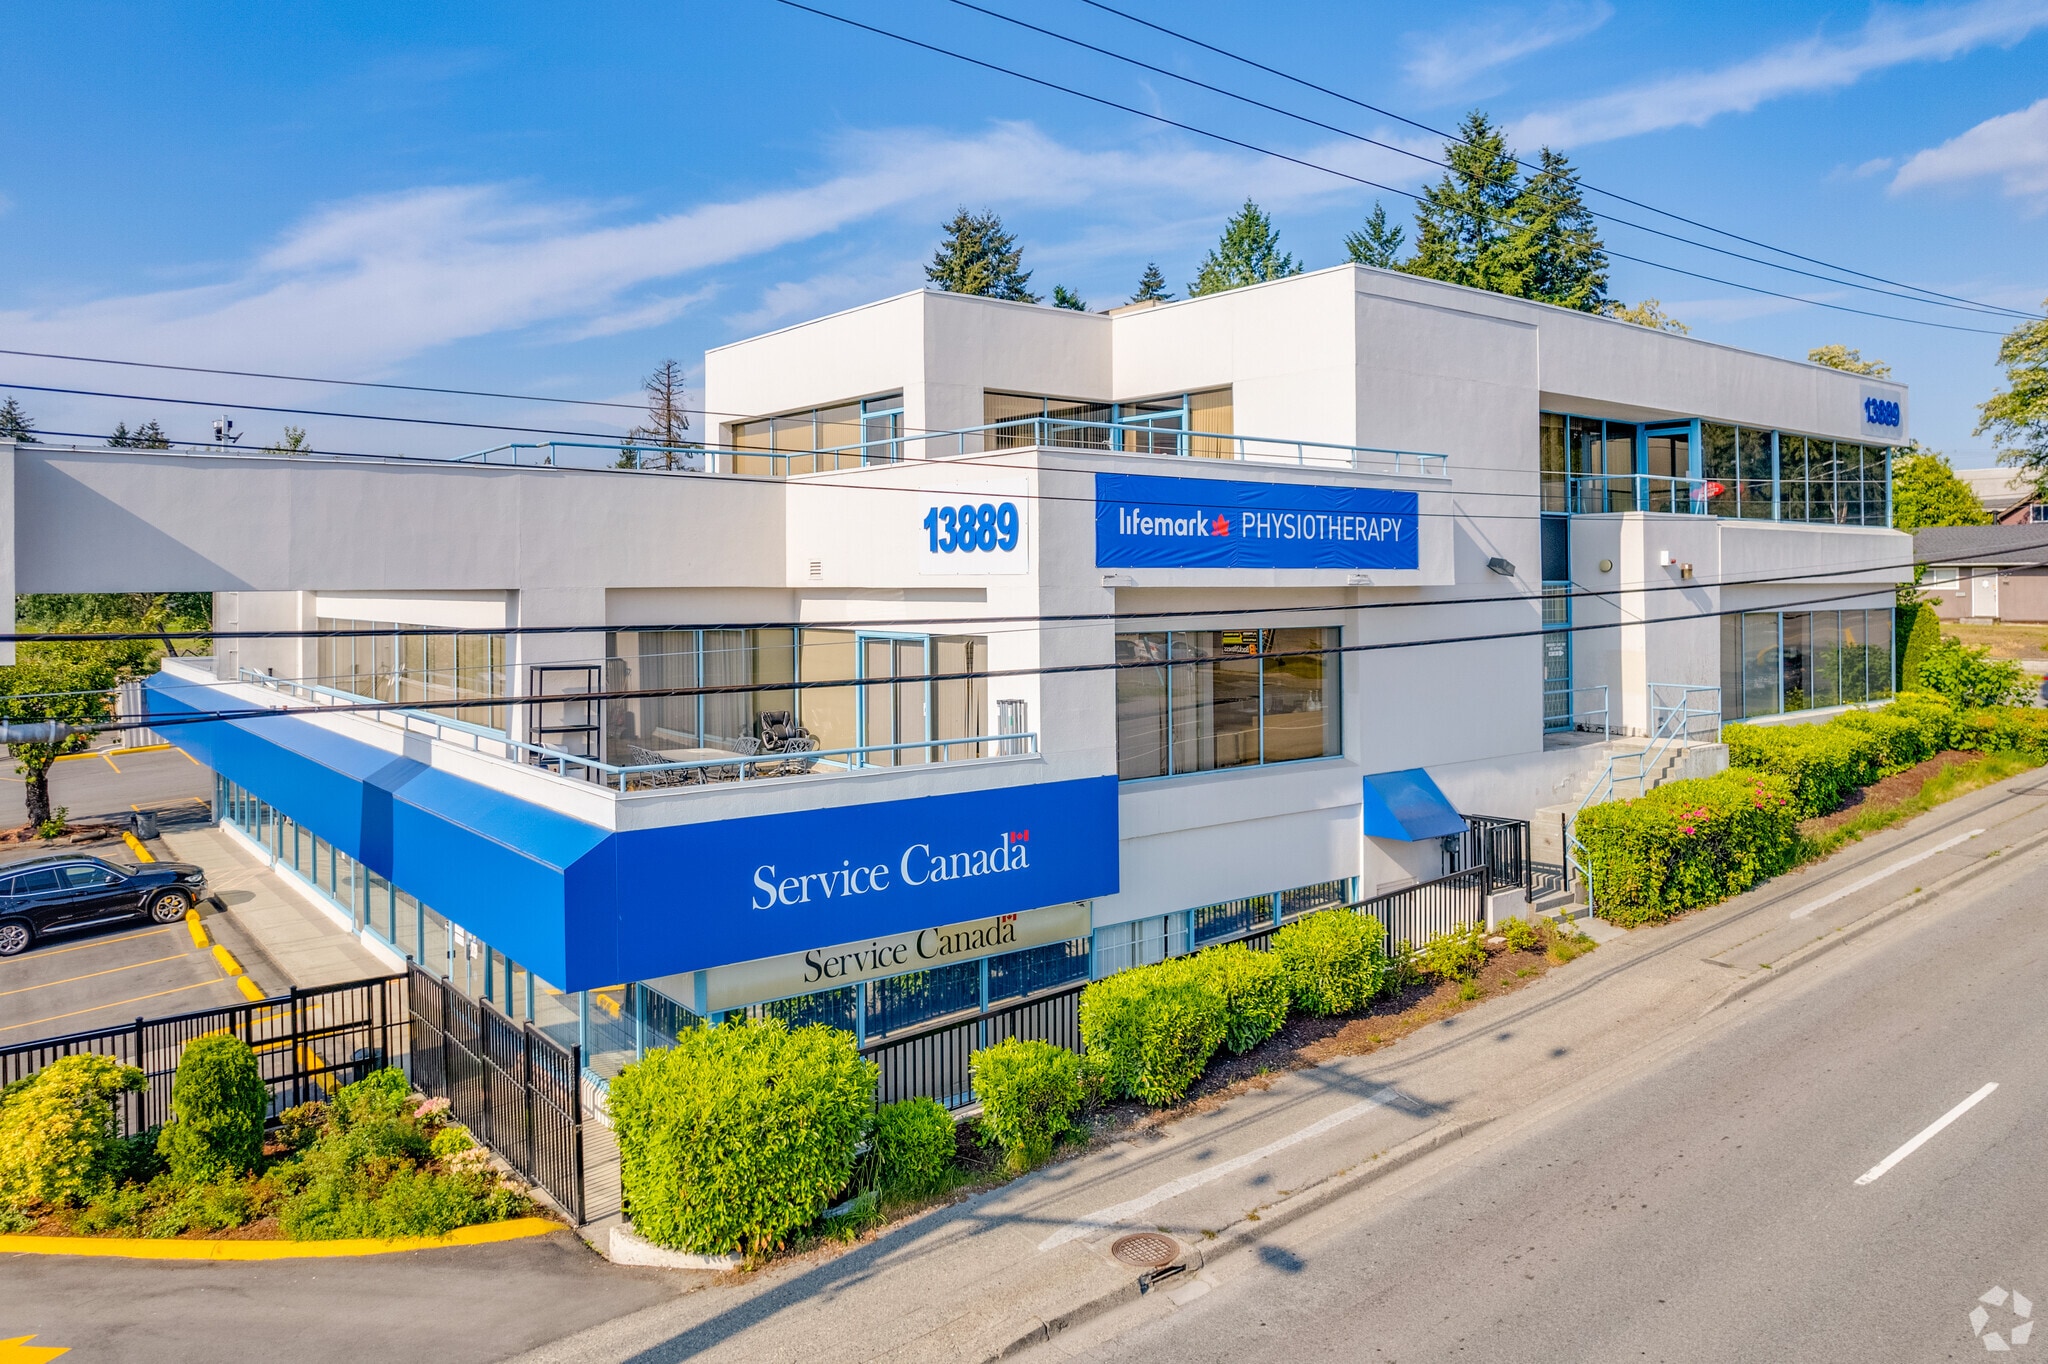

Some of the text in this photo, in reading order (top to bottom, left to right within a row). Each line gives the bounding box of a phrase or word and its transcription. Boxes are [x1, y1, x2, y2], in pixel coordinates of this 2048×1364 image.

[1865, 397, 1900, 427] 13889
[923, 502, 1020, 554] 13889
[1119, 507, 1402, 543] lifemark PHYSIOTHERAPY
[752, 832, 1030, 911] Service Canada
[804, 916, 1017, 983] Service Canada
